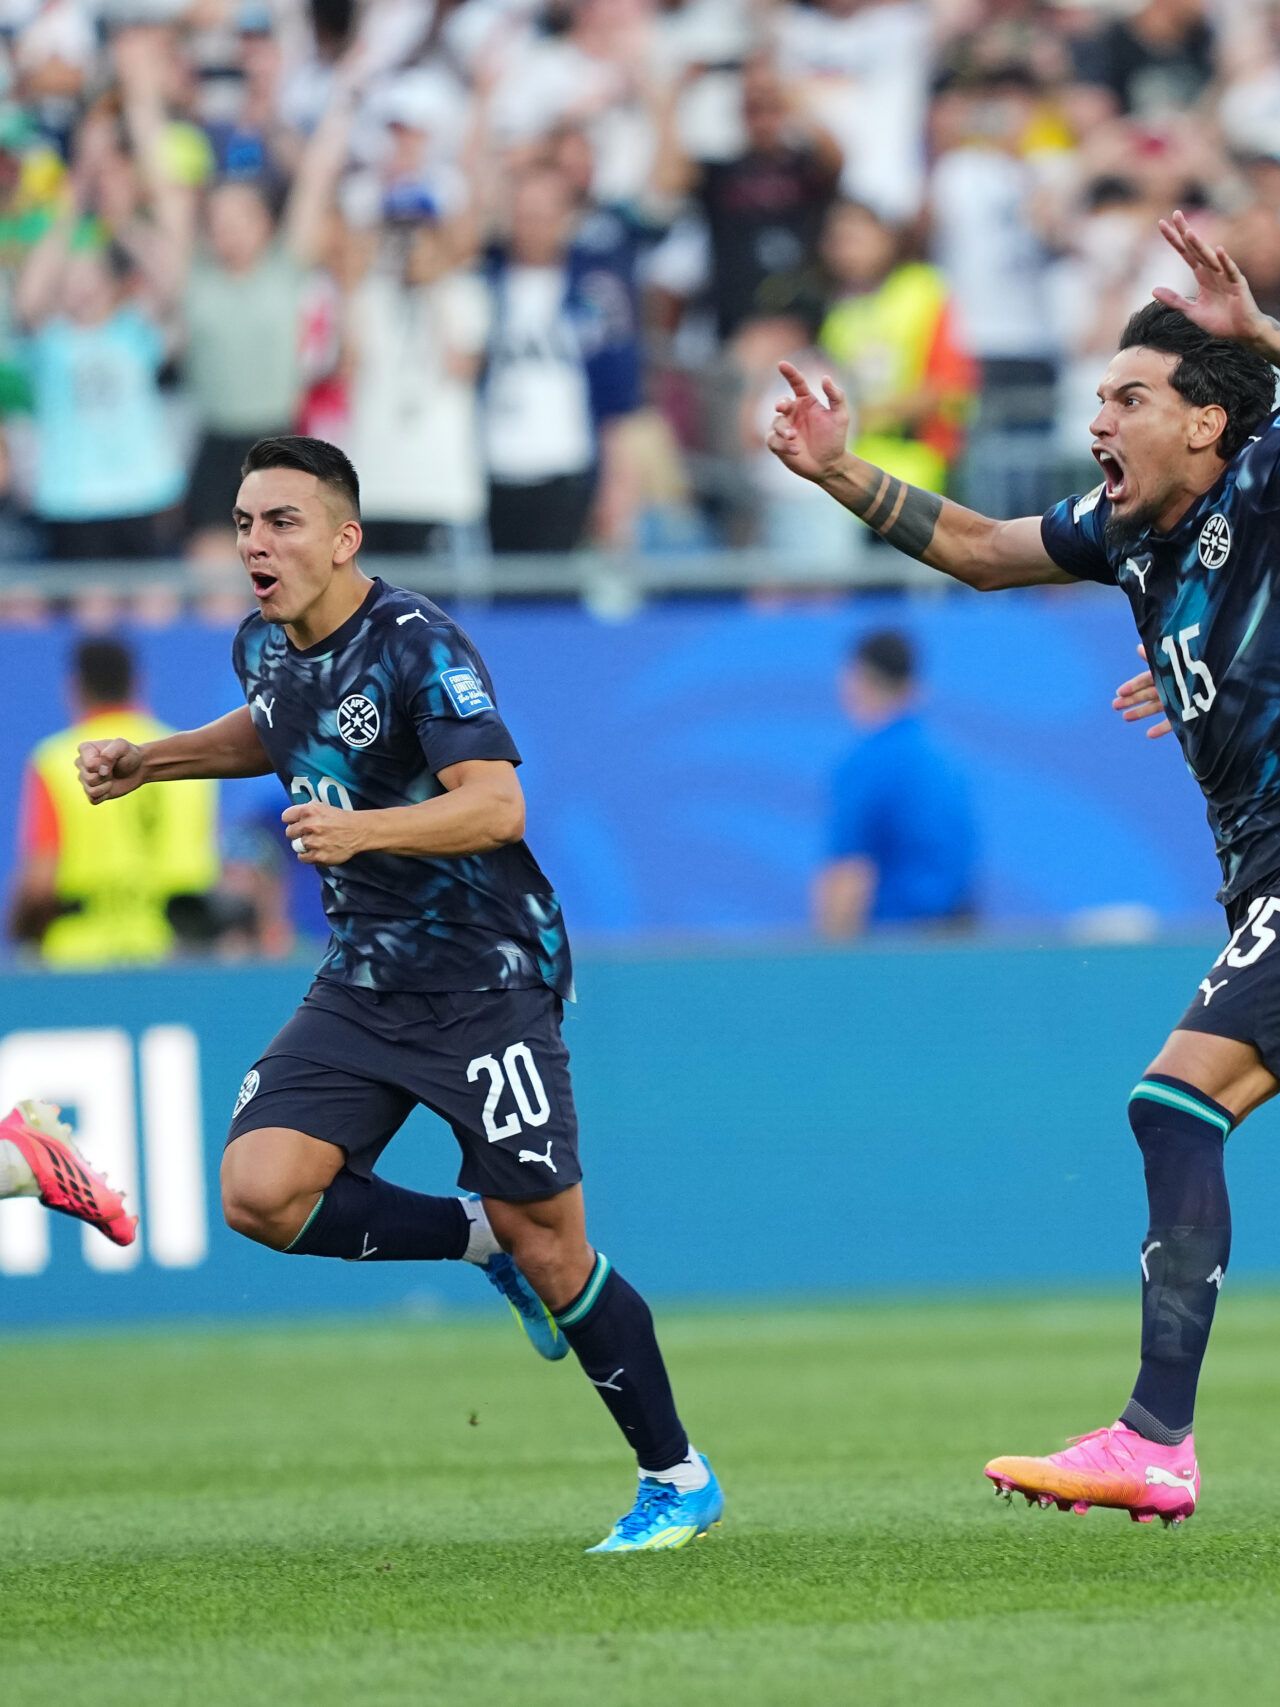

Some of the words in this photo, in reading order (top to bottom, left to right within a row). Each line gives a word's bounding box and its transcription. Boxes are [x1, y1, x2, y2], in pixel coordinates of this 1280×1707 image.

[350, 699, 366, 708] APF
[1161, 622, 1217, 722] 15
[466, 1041, 551, 1143] 20
